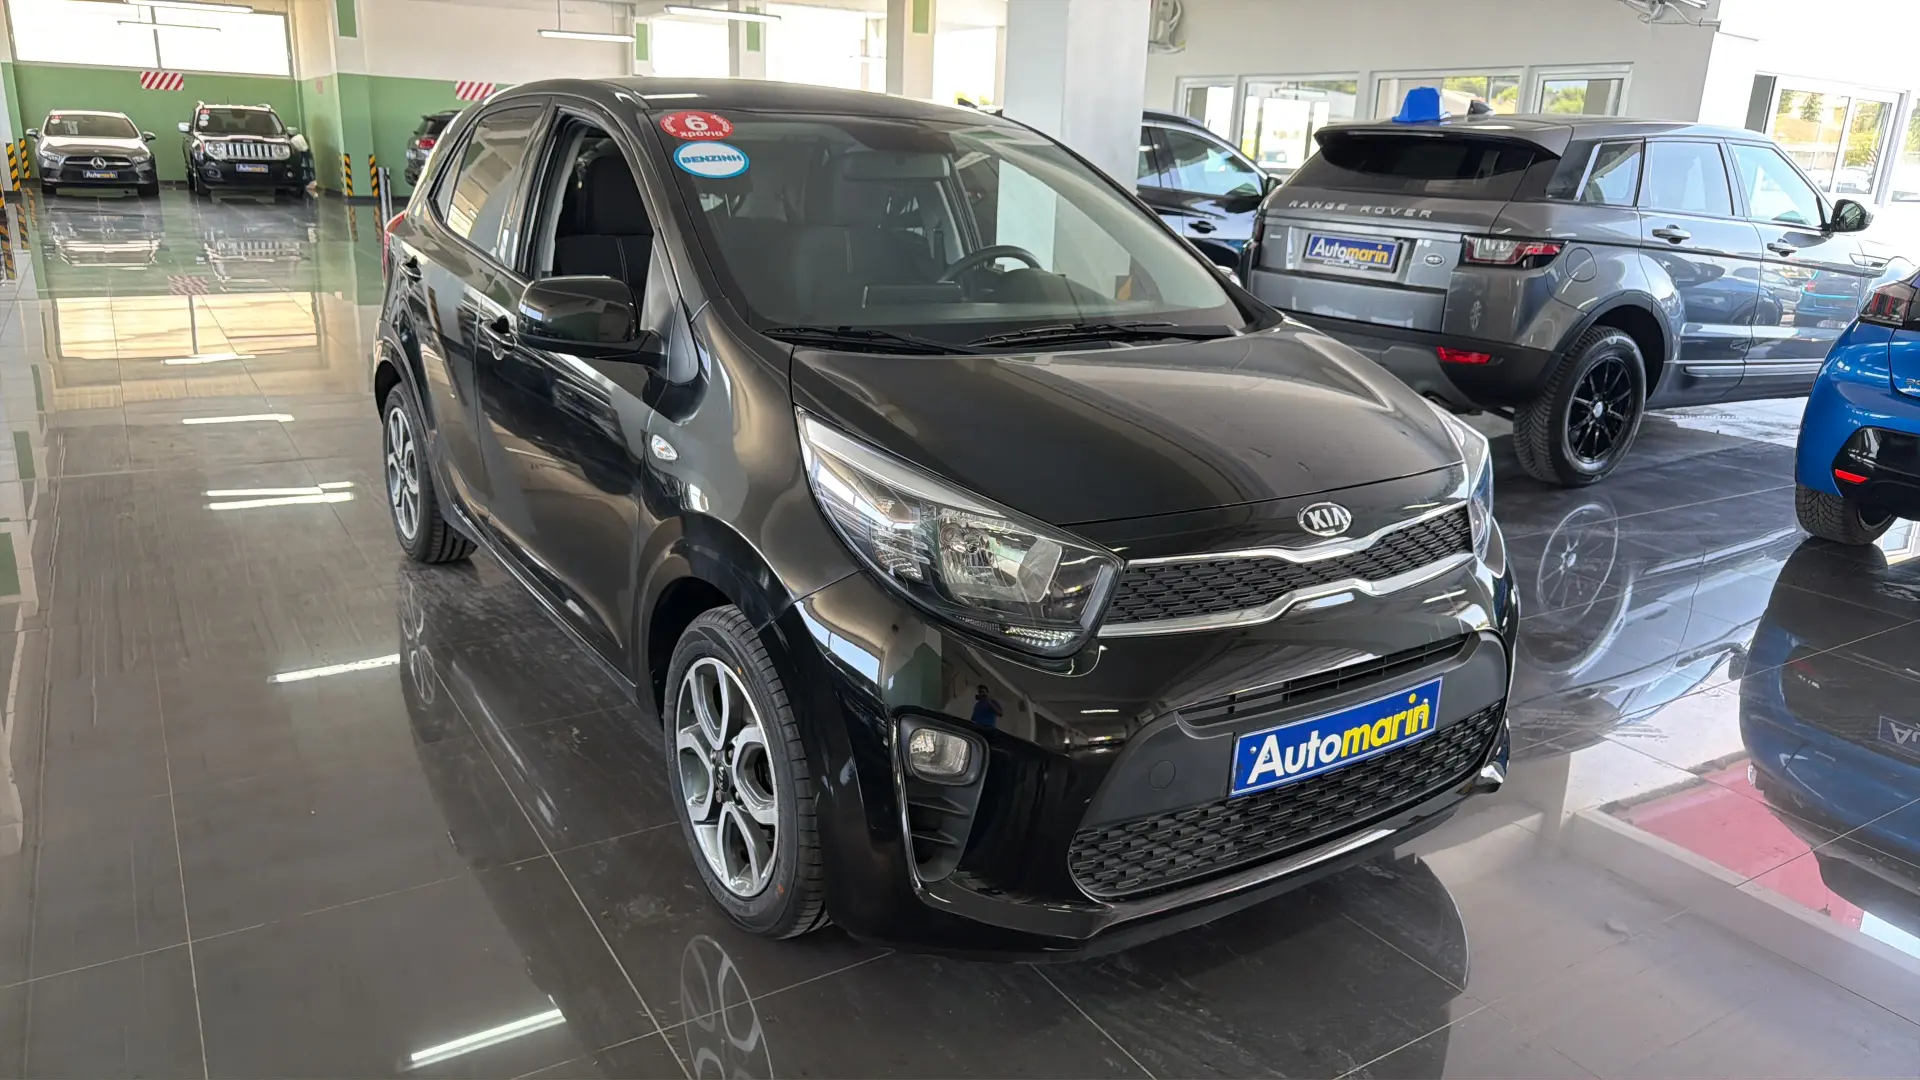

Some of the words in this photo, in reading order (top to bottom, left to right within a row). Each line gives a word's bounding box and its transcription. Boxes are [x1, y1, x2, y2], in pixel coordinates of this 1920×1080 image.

[685, 117, 709, 131] 6
[1289, 200, 1348, 211] RANGE
[1360, 205, 1433, 219] ROVER
[1311, 238, 1389, 264] Automarin
[1307, 507, 1348, 530] KIA
[1247, 693, 1430, 784] Automarin
